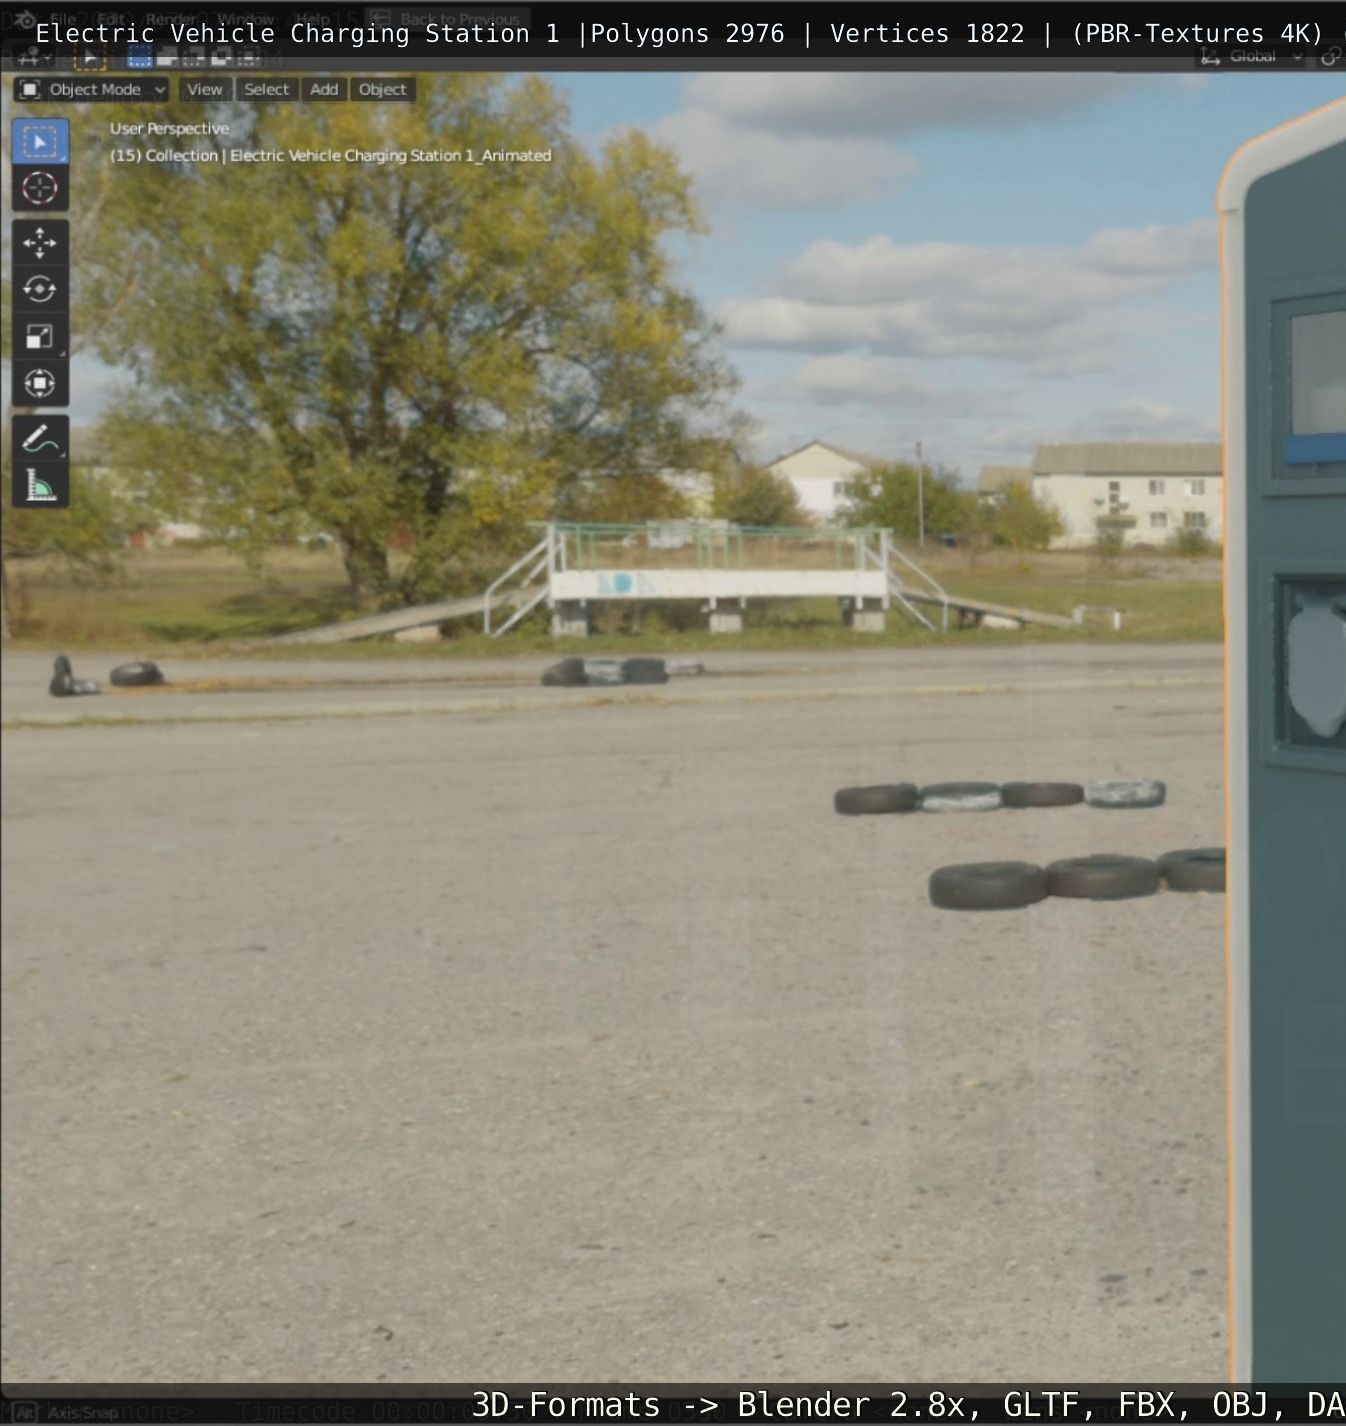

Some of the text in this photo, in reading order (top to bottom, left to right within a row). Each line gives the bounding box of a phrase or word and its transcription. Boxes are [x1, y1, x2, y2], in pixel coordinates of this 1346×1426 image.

[50, 14, 77, 26] File
[97, 14, 126, 26] Edit
[146, 14, 197, 26] Render
[218, 14, 275, 26] Window
[296, 14, 331, 28] Help
[401, 14, 520, 26] Back to Previous
[1230, 46, 1277, 62] Global
[50, 83, 141, 98] Object Mode
[187, 83, 223, 96] View
[244, 83, 289, 96] Select
[309, 83, 339, 96] Add
[359, 83, 407, 98] Object
[110, 122, 230, 138] User Perspective
[110, 149, 142, 164] (15)
[146, 149, 219, 162] Collection
[230, 149, 285, 162] Electric
[288, 149, 341, 162] Vehicle
[345, 149, 407, 165] Charging
[410, 149, 461, 162] Station
[465, 149, 552, 165] 1_Animated
[48, 1406, 120, 1422] Axis Snap
